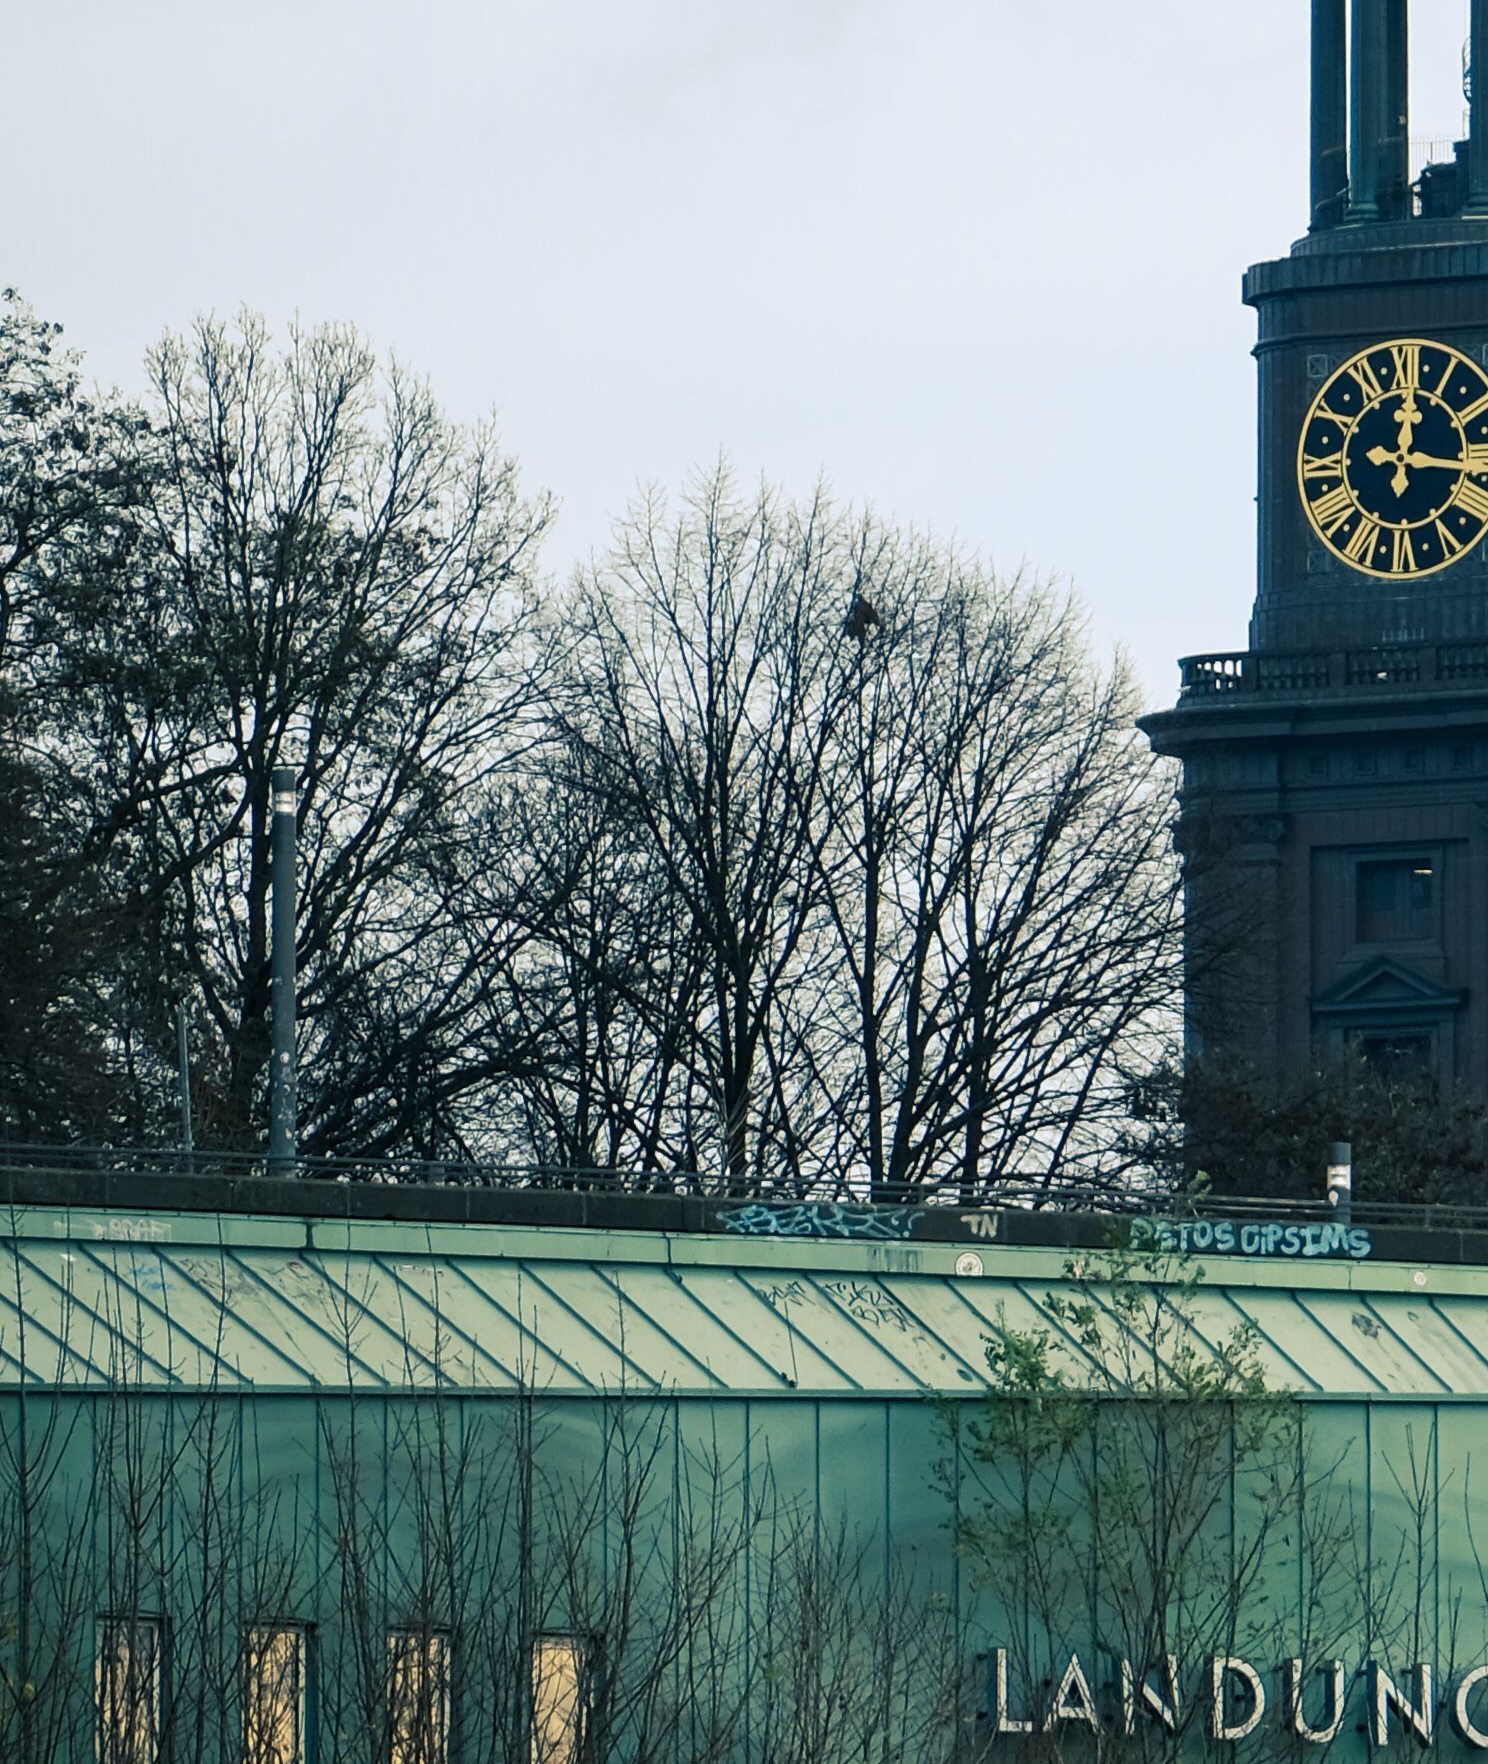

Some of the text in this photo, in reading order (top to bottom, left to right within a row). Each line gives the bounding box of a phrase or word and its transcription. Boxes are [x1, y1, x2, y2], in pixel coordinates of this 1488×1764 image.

[1347, 356, 1383, 405] XI
[1390, 345, 1421, 389] XII
[1314, 398, 1355, 436] X
[1303, 450, 1343, 480] IX
[1310, 482, 1357, 538] VIII
[1342, 516, 1380, 568] VII
[1390, 529, 1419, 573] VI
[1434, 518, 1465, 559] V
